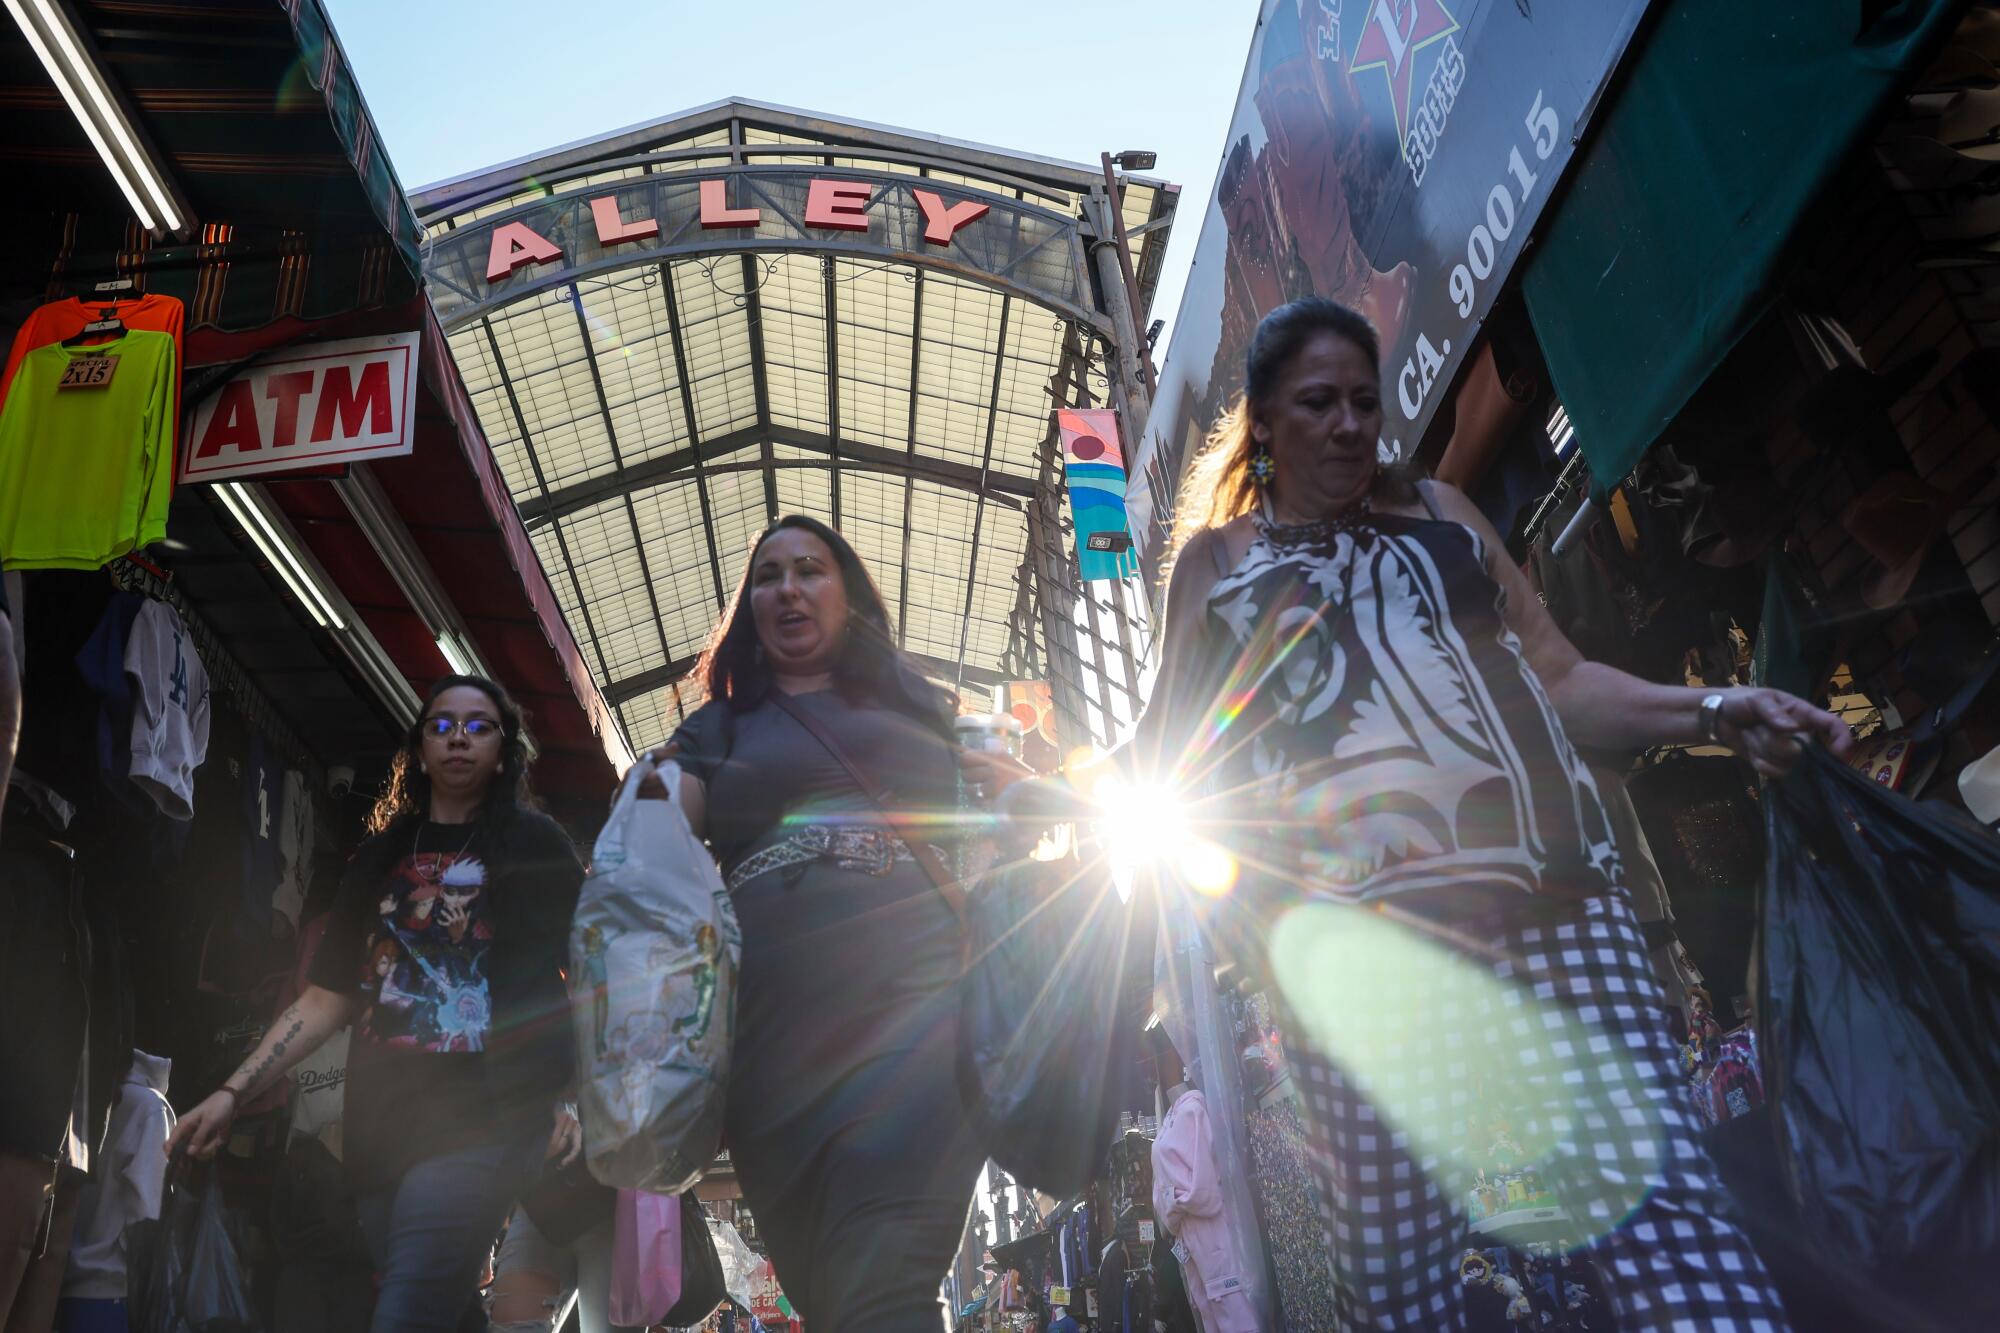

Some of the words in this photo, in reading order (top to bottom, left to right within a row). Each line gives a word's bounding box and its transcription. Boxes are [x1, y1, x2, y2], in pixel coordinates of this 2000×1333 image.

[1404, 35, 1466, 187] BOOTS
[486, 179, 990, 284] ALLEY
[1398, 332, 1451, 420] CA.
[1449, 89, 1560, 319] 90015
[70, 359, 112, 367] SPECIAL
[195, 361, 393, 459] ATM
[168, 630, 188, 714] LA
[751, 1299, 761, 1307] DE
